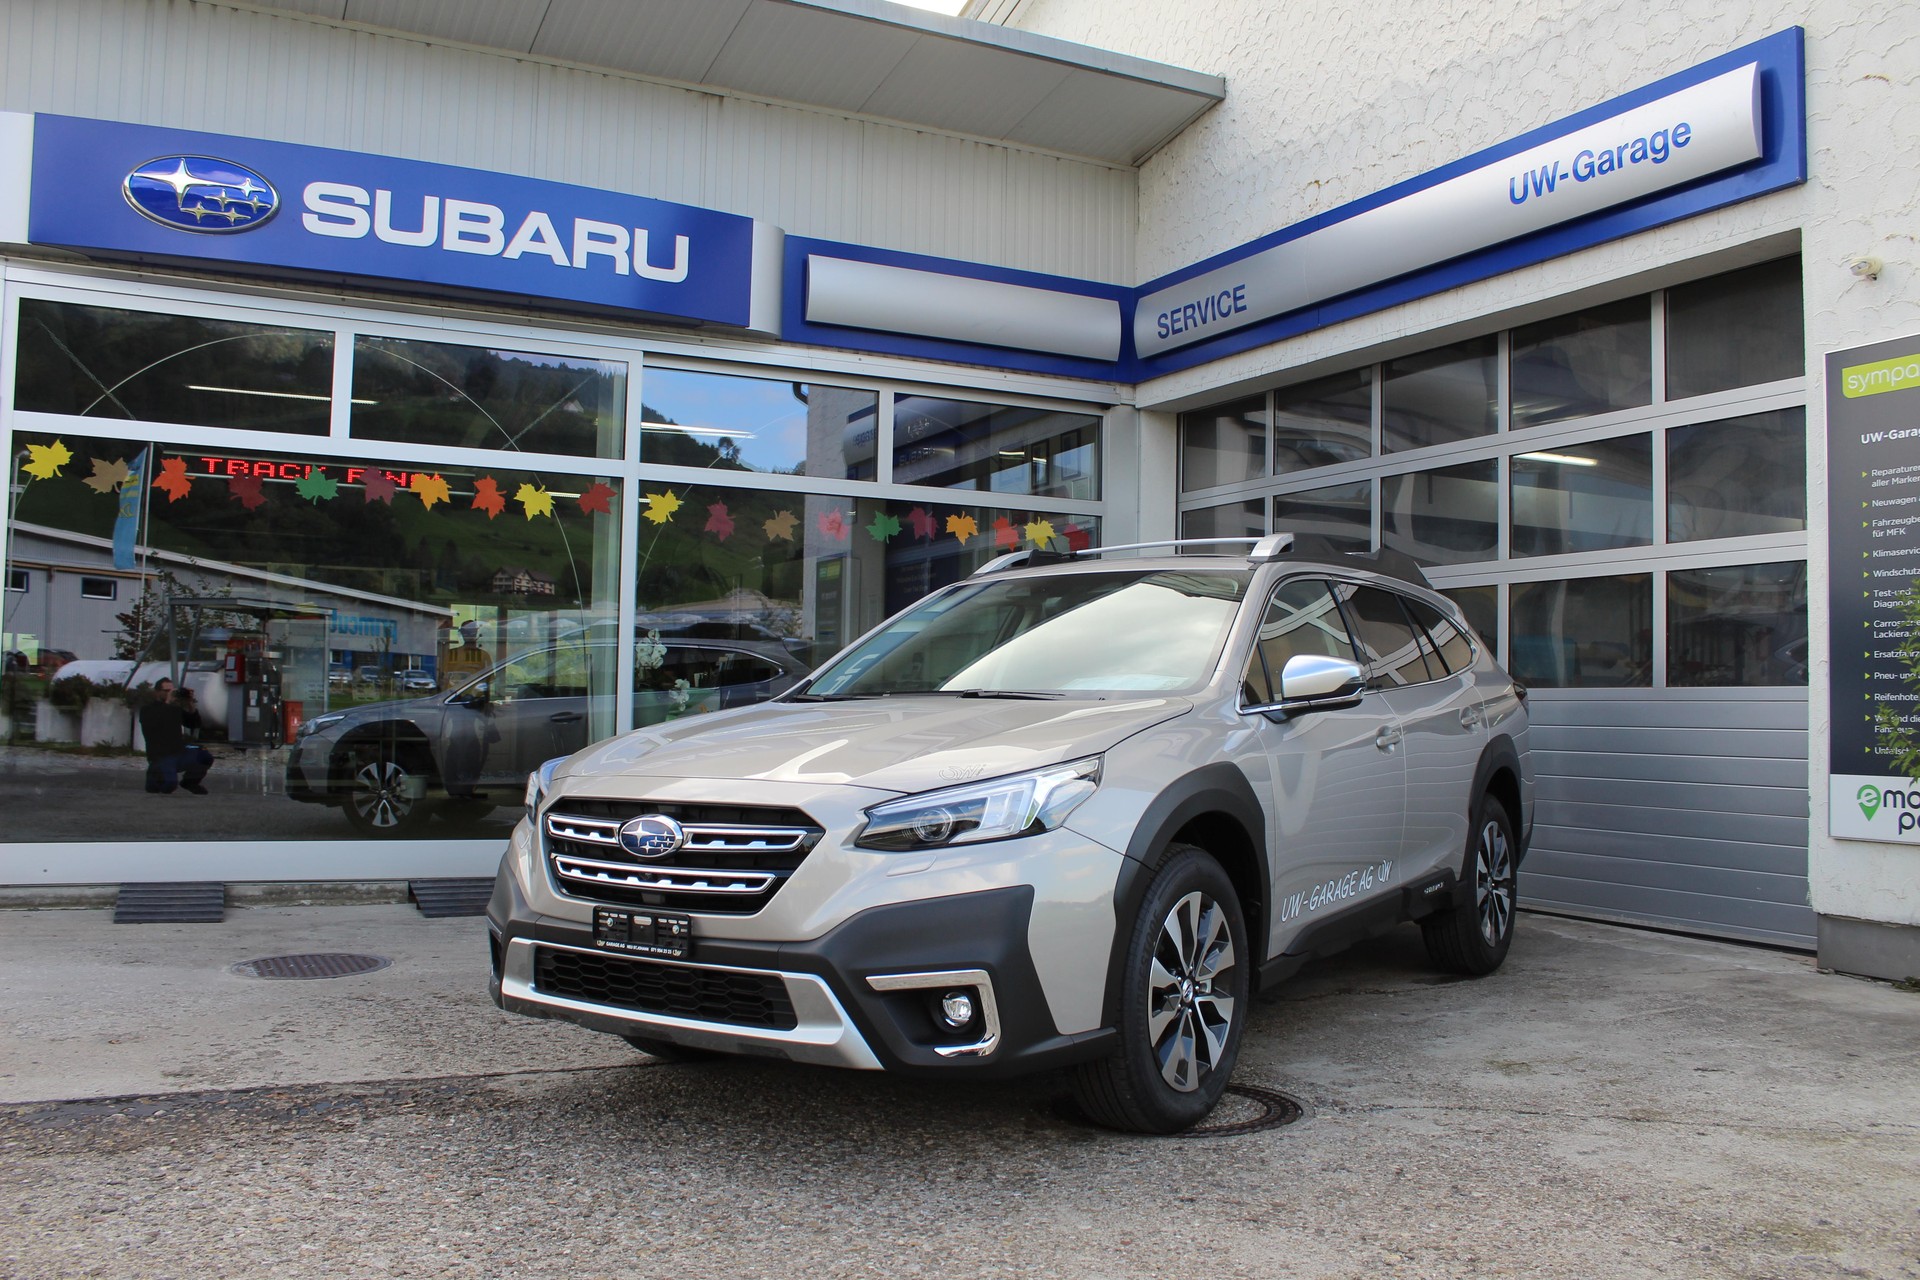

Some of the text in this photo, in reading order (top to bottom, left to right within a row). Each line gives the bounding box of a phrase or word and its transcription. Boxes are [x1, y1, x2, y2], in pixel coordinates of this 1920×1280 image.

[1509, 122, 1691, 205] UW-Garage
[302, 182, 690, 284] SUBARU
[1157, 284, 1247, 339] SERVICE
[1871, 479, 1890, 488] aller
[1872, 496, 1917, 507] Neuwagen
[1872, 527, 1906, 538] für MFK
[1874, 672, 1898, 680] Pneu-
[1898, 811, 1920, 835] p
[1281, 870, 1359, 922] UW-GARAGE
[1358, 865, 1375, 893] AG
